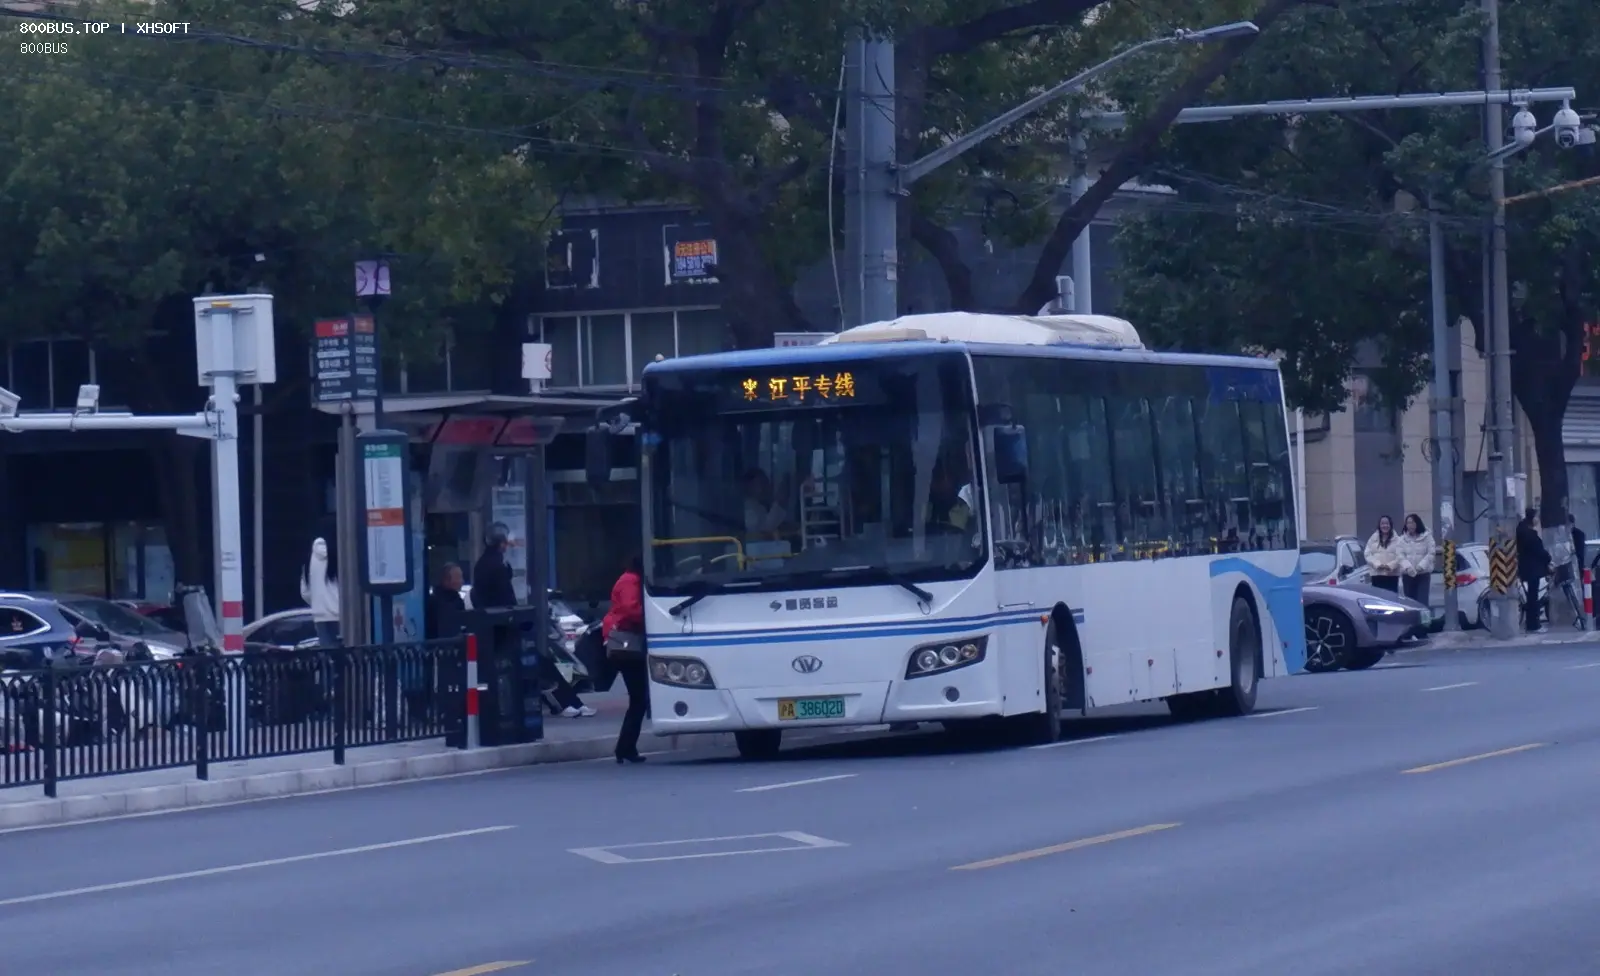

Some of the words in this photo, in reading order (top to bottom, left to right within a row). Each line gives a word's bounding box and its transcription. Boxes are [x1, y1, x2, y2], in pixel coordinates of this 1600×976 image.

[769, 372, 854, 400] 江平专线
[799, 700, 843, 716] 38602D
